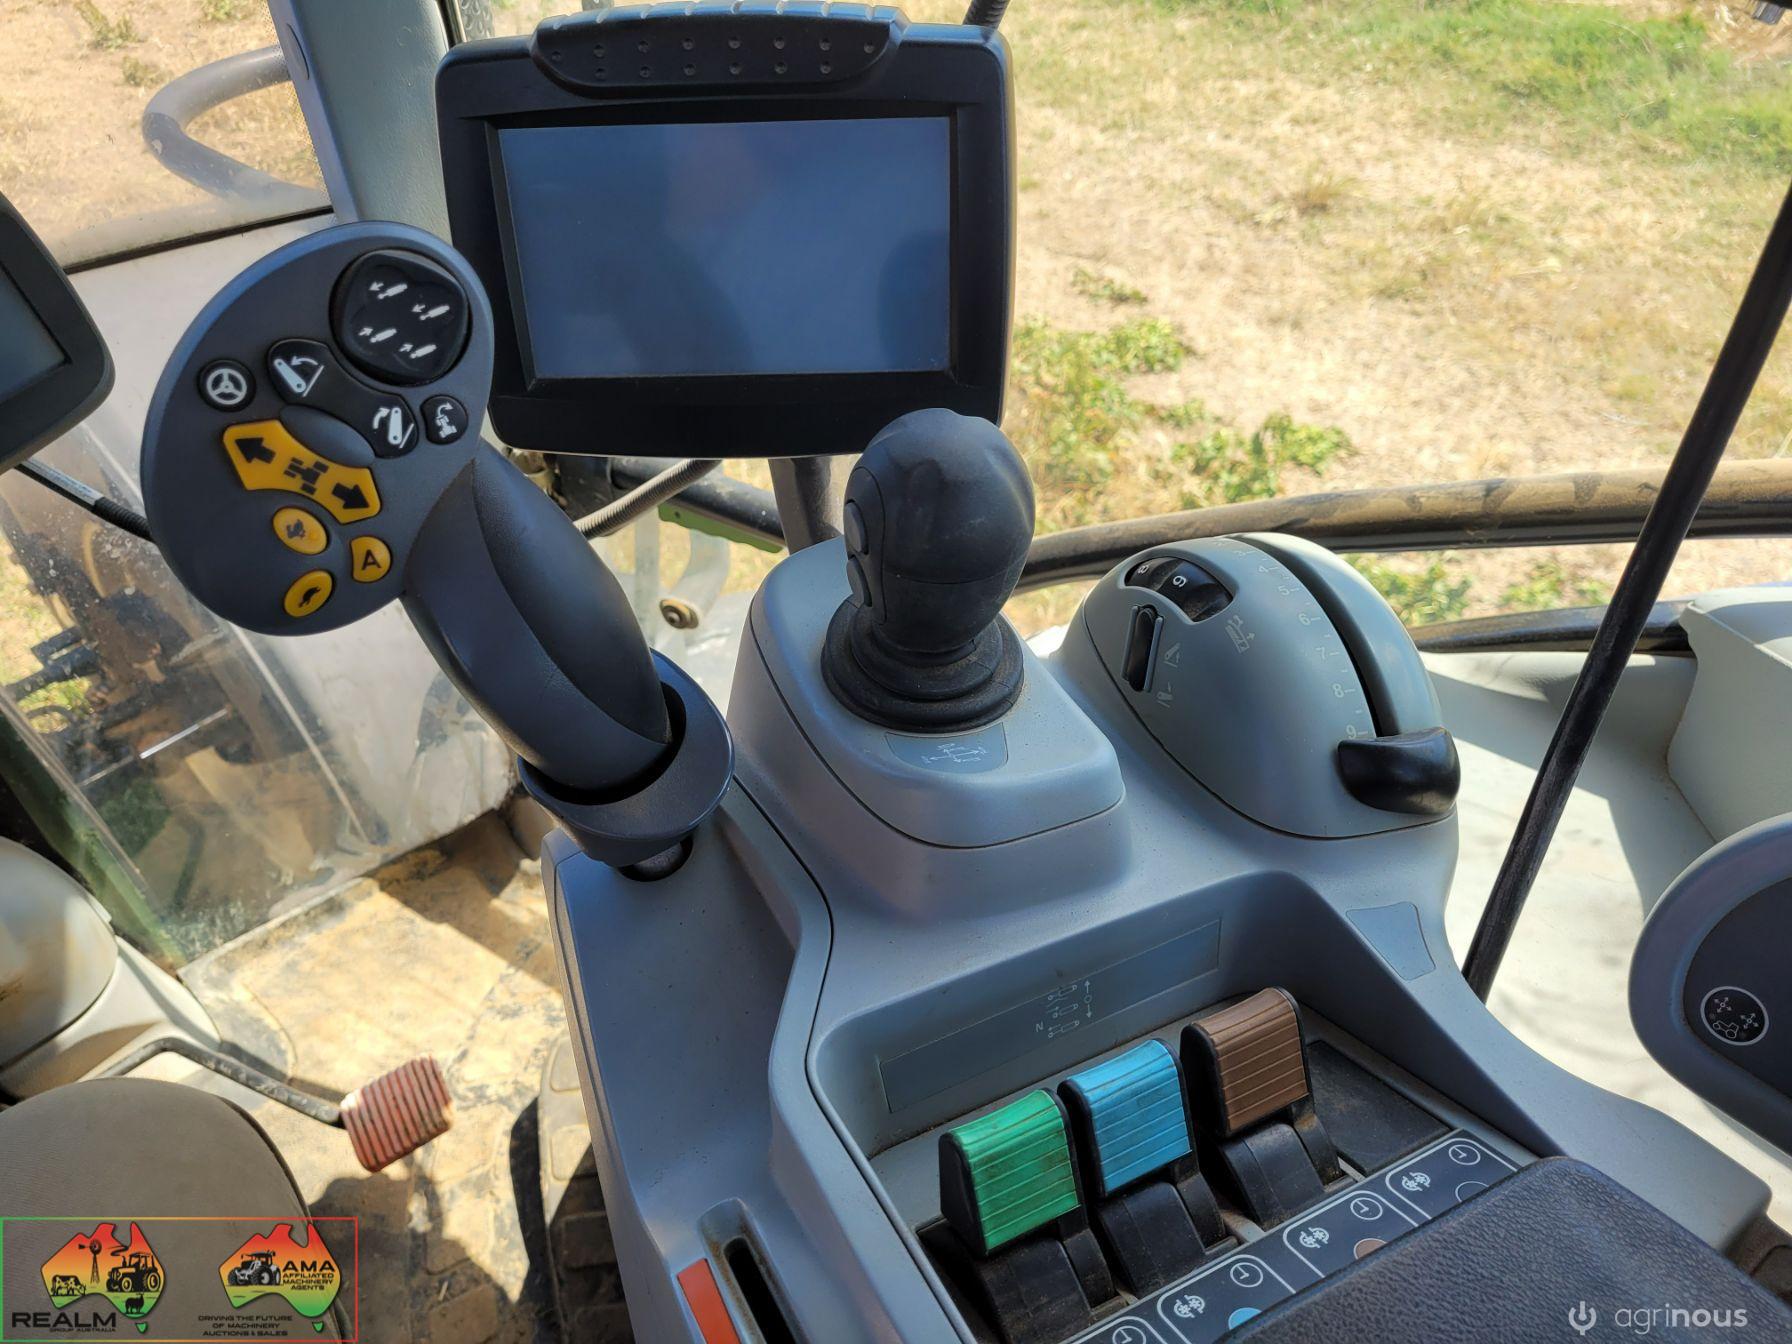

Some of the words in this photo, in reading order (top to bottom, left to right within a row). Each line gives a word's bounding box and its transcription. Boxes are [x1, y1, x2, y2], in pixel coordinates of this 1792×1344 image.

[361, 549, 382, 570] A
[1278, 585, 1290, 595] 5
[1298, 613, 1311, 625] 6
[1315, 647, 1325, 659] 7
[1332, 683, 1344, 698] 8
[1346, 724, 1357, 739] 9
[1035, 1021, 1044, 1032] N
